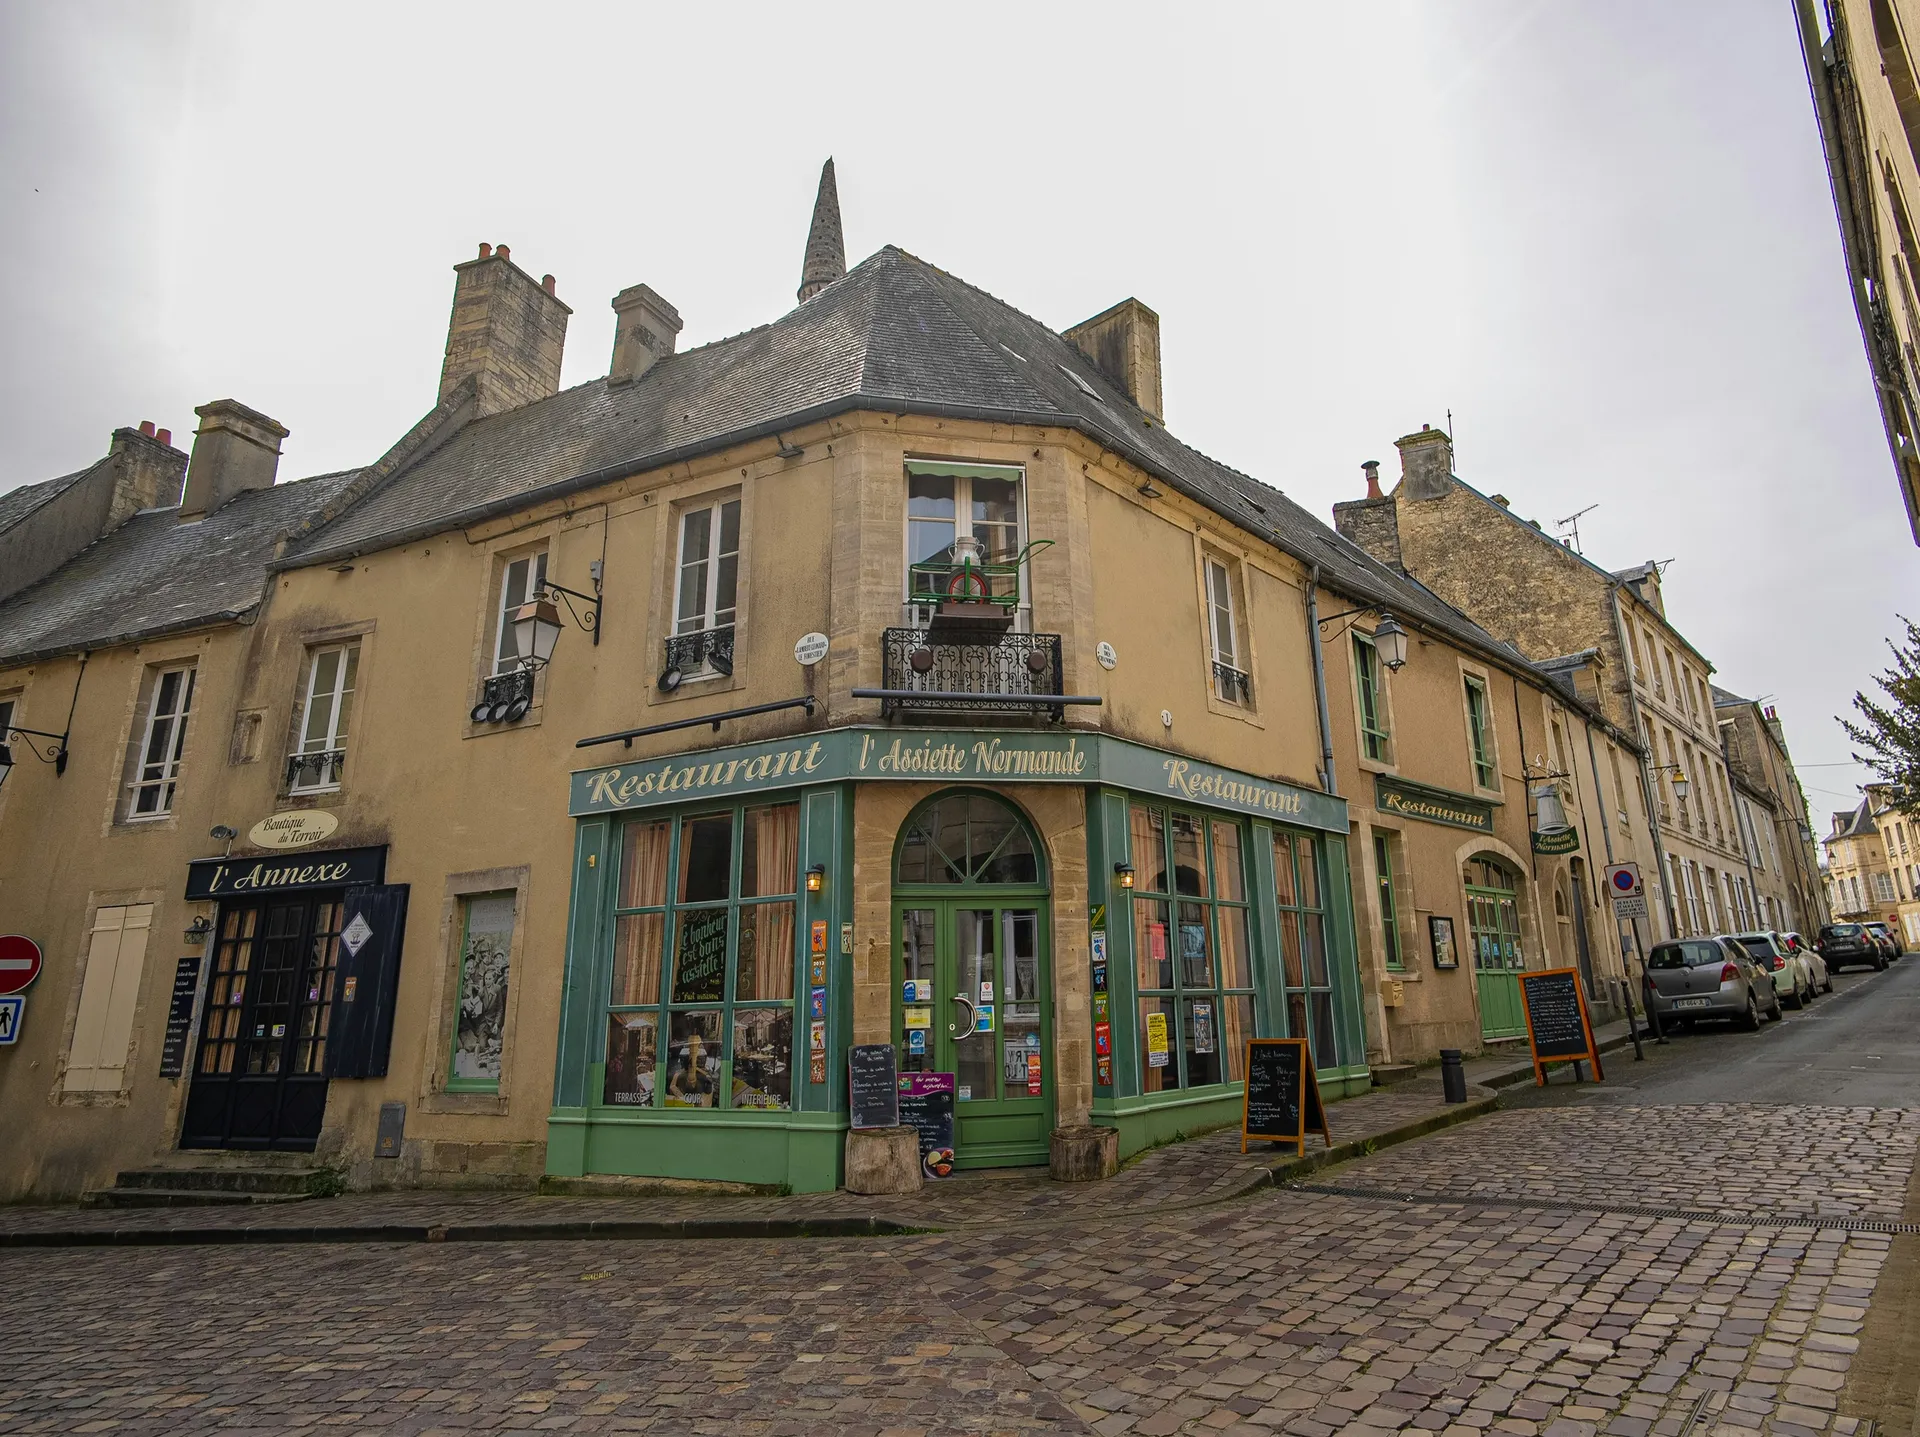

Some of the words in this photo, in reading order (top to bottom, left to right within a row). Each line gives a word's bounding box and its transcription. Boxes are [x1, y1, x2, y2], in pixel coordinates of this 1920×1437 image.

[858, 734, 875, 771] l'
[878, 737, 968, 774] Assiette
[971, 737, 1087, 776] Normande
[585, 740, 828, 807] Restaurant
[1162, 758, 1304, 816] Restaurant
[263, 814, 307, 833] Boutique
[1382, 792, 1486, 827] Restaurant
[277, 831, 289, 844] du
[289, 826, 325, 843] Terroir
[1535, 838, 1577, 851] Normande
[208, 865, 230, 893] l'
[233, 861, 352, 890] Annexe
[690, 914, 728, 945] bonheur
[682, 942, 698, 967] est
[699, 929, 726, 958] dans
[684, 1092, 702, 1104] COUR
